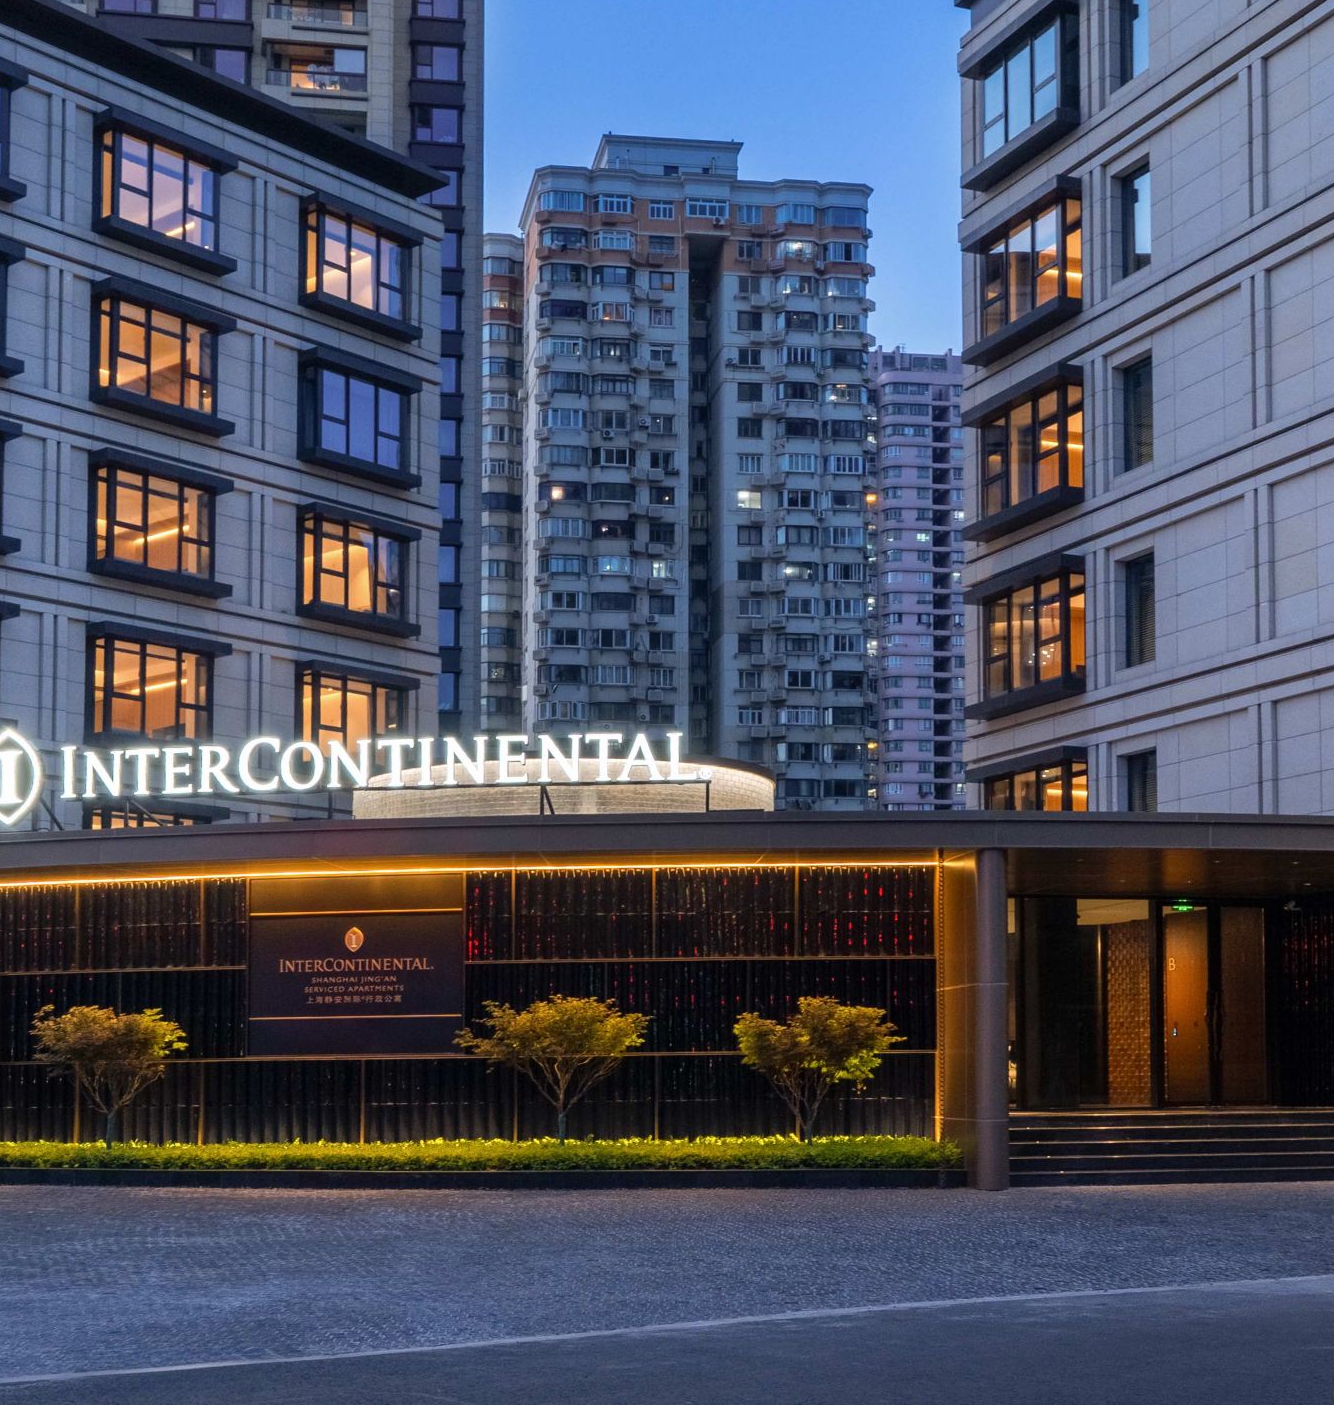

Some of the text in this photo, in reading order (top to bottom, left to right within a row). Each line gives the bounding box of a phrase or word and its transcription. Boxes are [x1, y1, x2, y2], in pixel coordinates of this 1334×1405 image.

[311, 975, 397, 984] SHANGHAI JING'AN
[304, 984, 405, 994] SERVICED APARTMENTS
